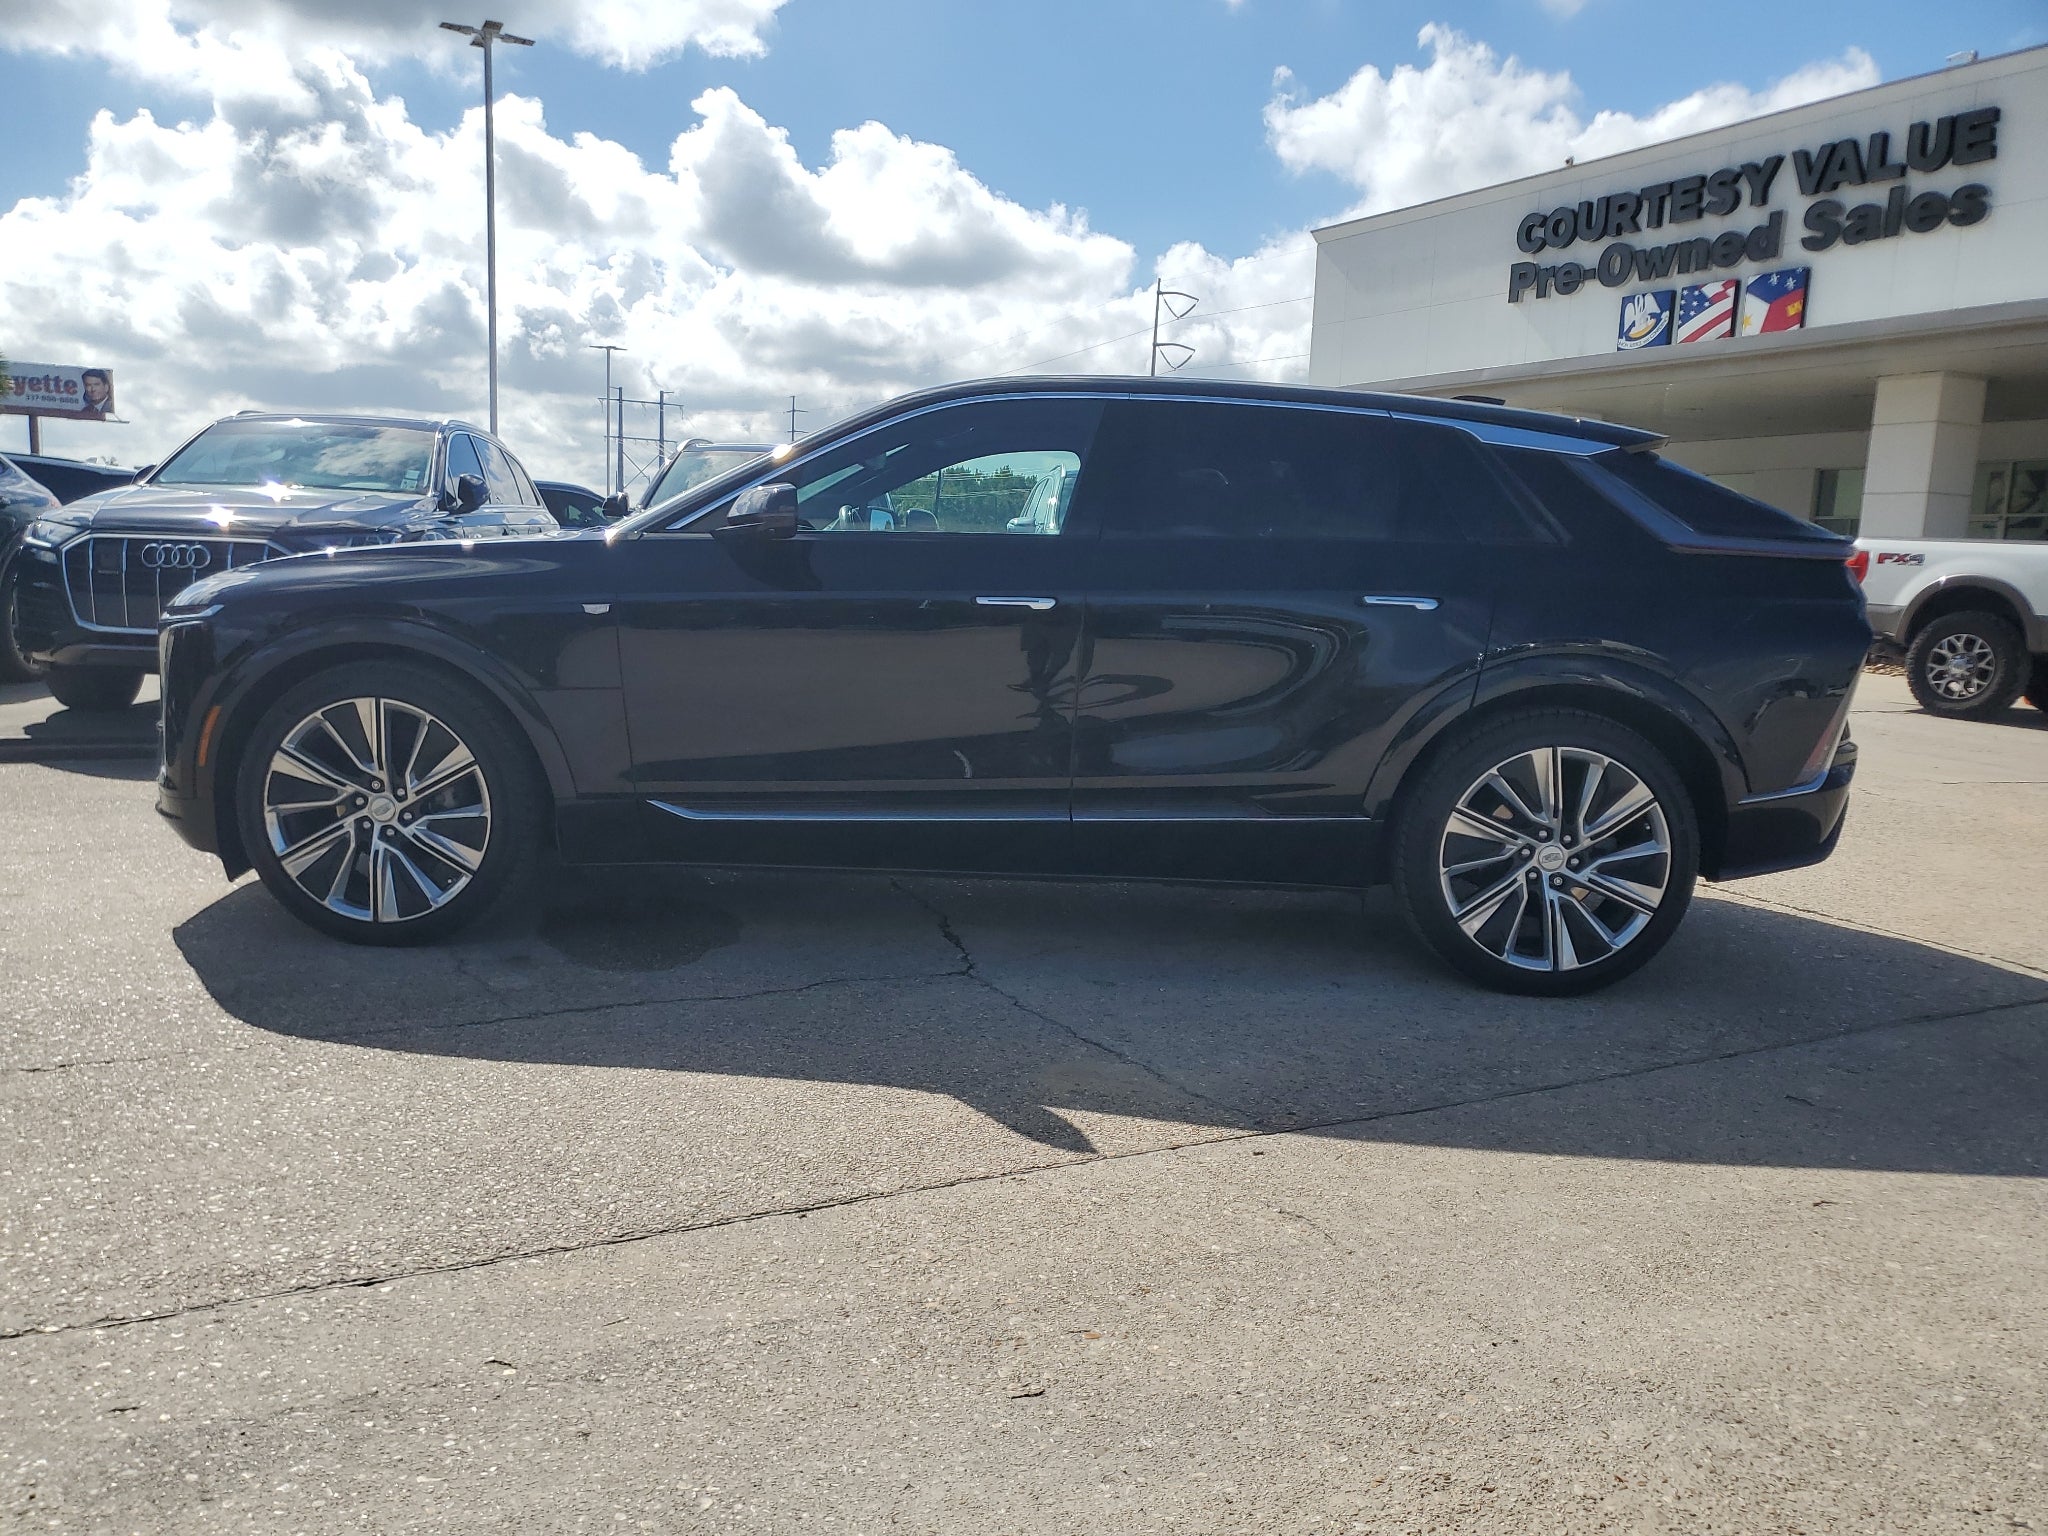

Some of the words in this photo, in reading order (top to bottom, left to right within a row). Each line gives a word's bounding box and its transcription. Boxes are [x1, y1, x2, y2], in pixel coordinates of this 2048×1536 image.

[1516, 154, 1786, 254] COURTESY
[1792, 106, 2001, 196] VALUE
[1508, 209, 1783, 303] Pre-Owned
[1801, 182, 1992, 251] Sales
[1876, 552, 1926, 565] FX4
